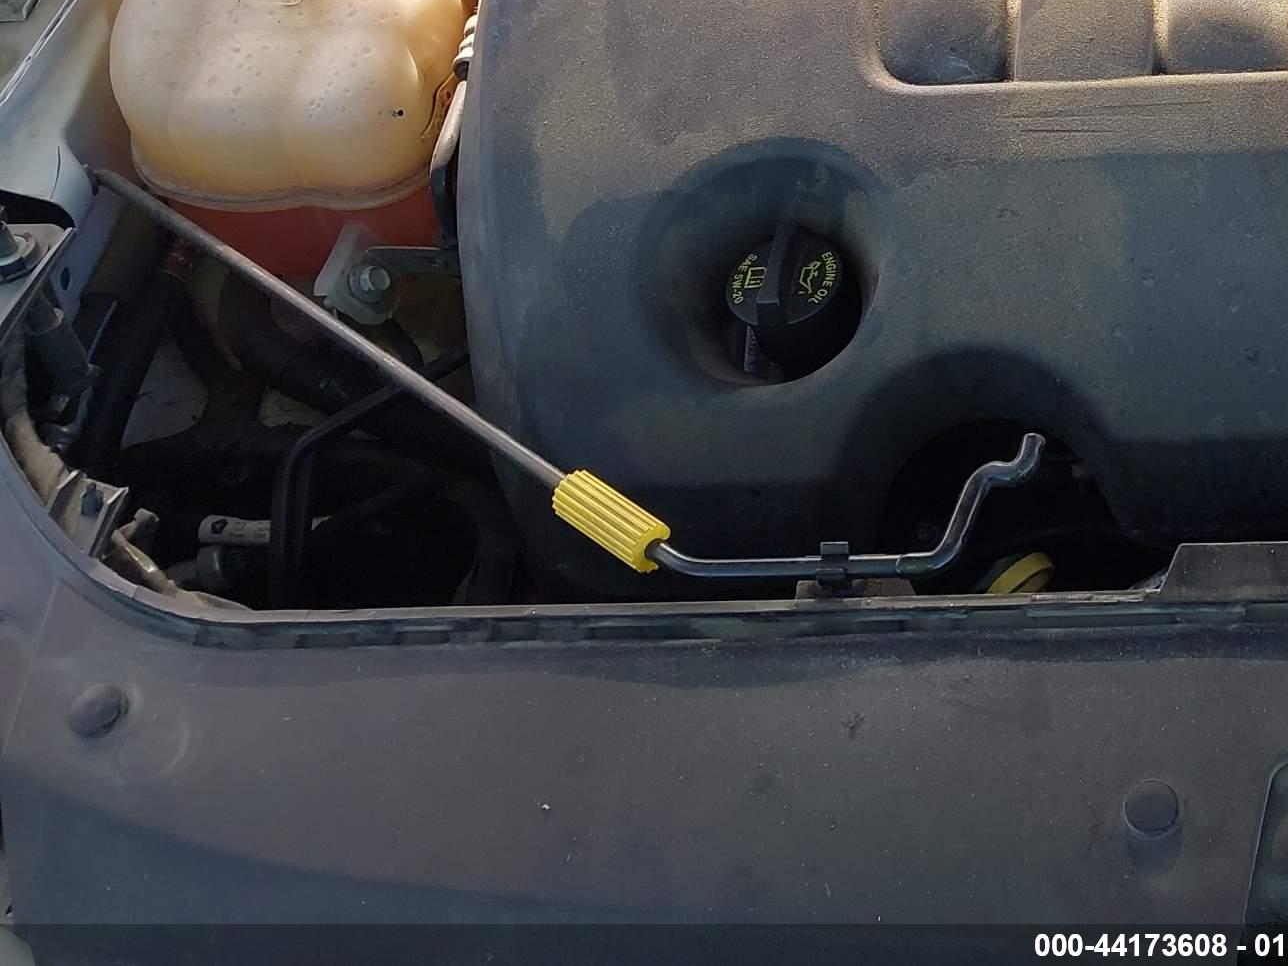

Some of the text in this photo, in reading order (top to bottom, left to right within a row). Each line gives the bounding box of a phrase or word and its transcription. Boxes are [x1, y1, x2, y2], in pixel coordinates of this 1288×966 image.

[731, 253, 758, 305] SAE 5W-20
[807, 251, 837, 305] ENGINE OIL
